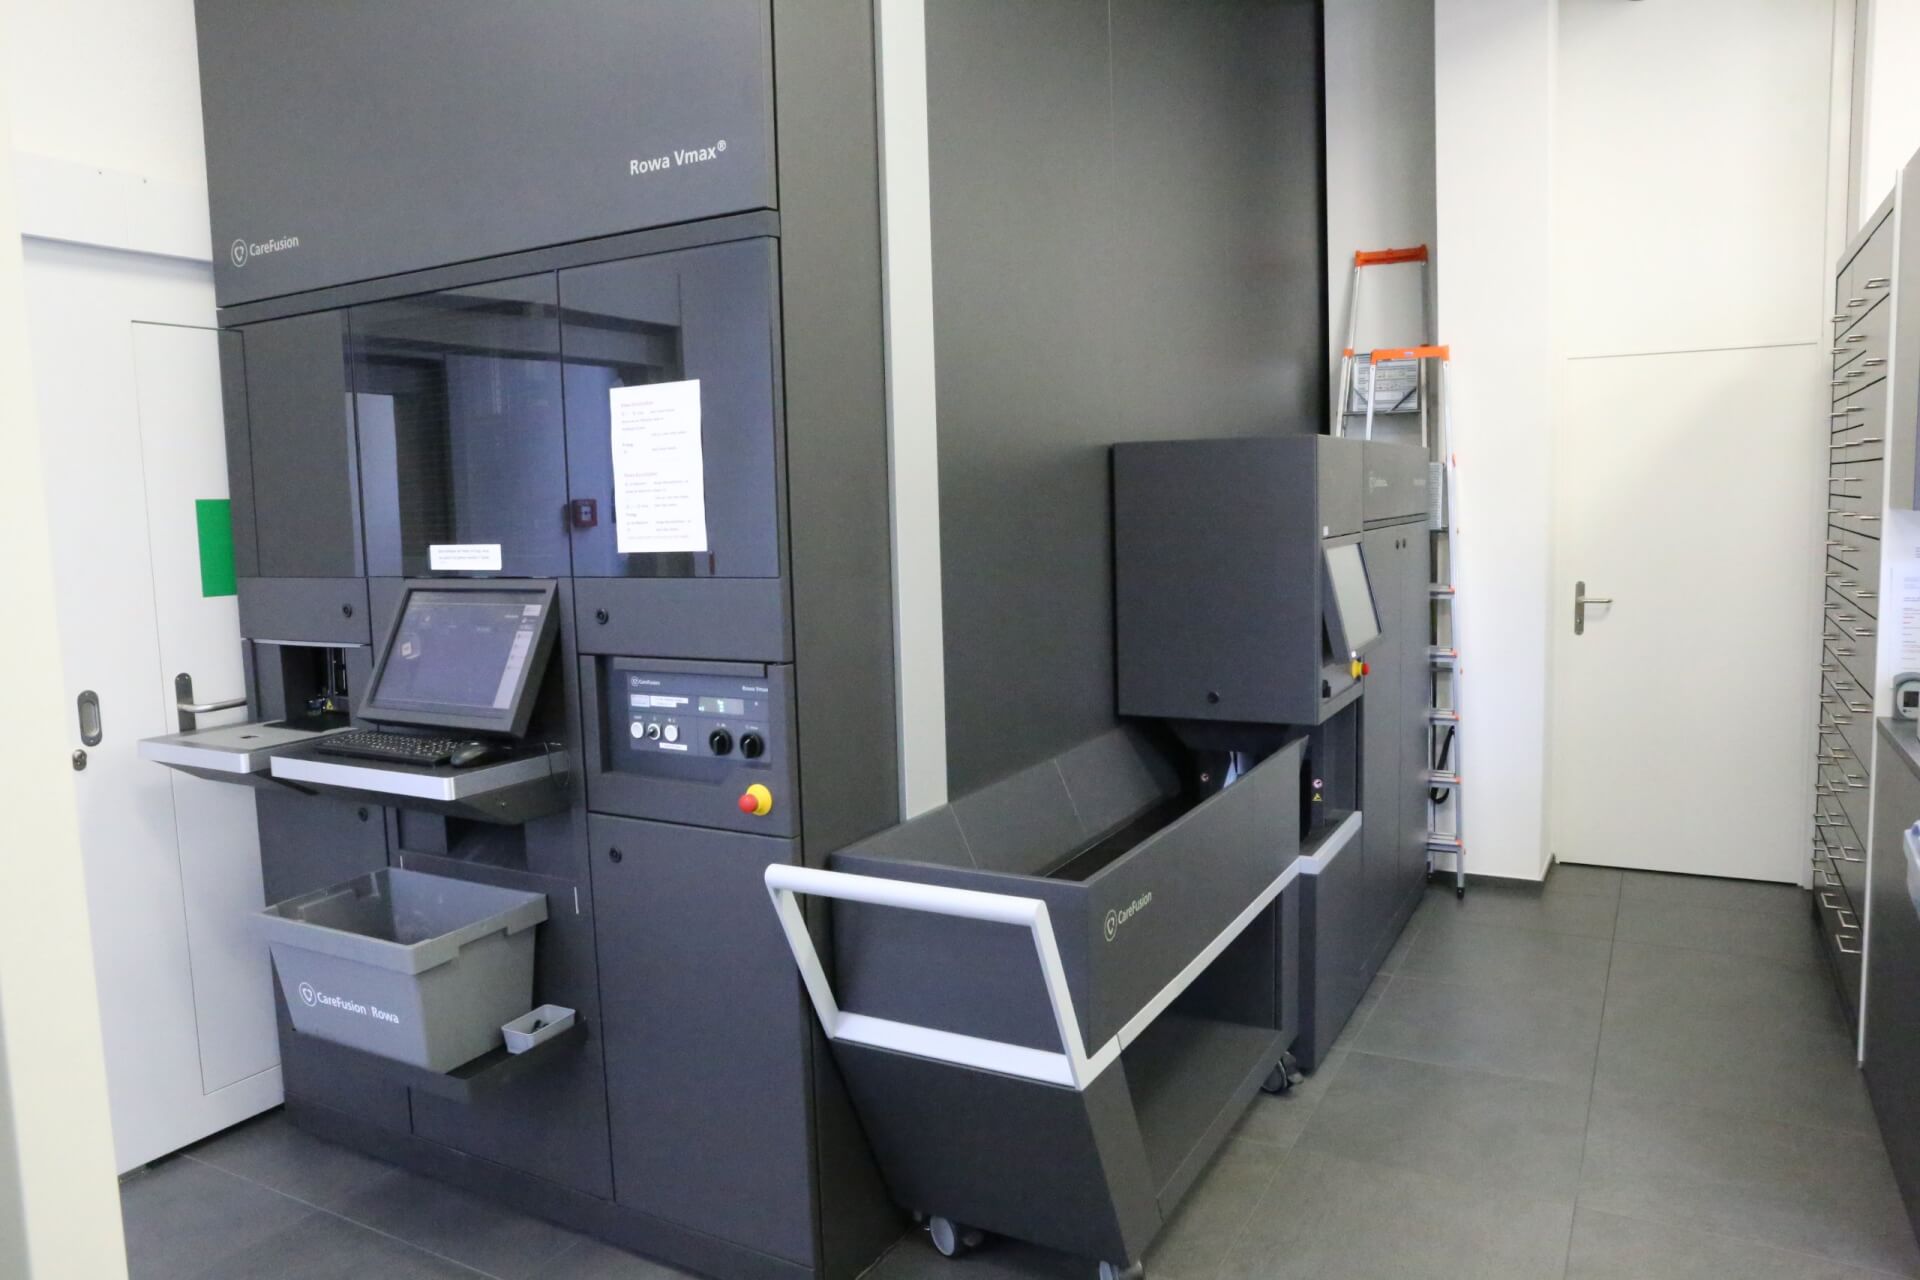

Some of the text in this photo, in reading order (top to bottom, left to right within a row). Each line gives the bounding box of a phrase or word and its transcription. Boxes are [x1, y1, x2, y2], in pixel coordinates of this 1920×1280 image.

[630, 156, 670, 176] Rowa
[249, 235, 299, 256] CareFusion
[1118, 891, 1152, 925] CareFusion
[317, 992, 400, 1024] CareFusion Rowa
